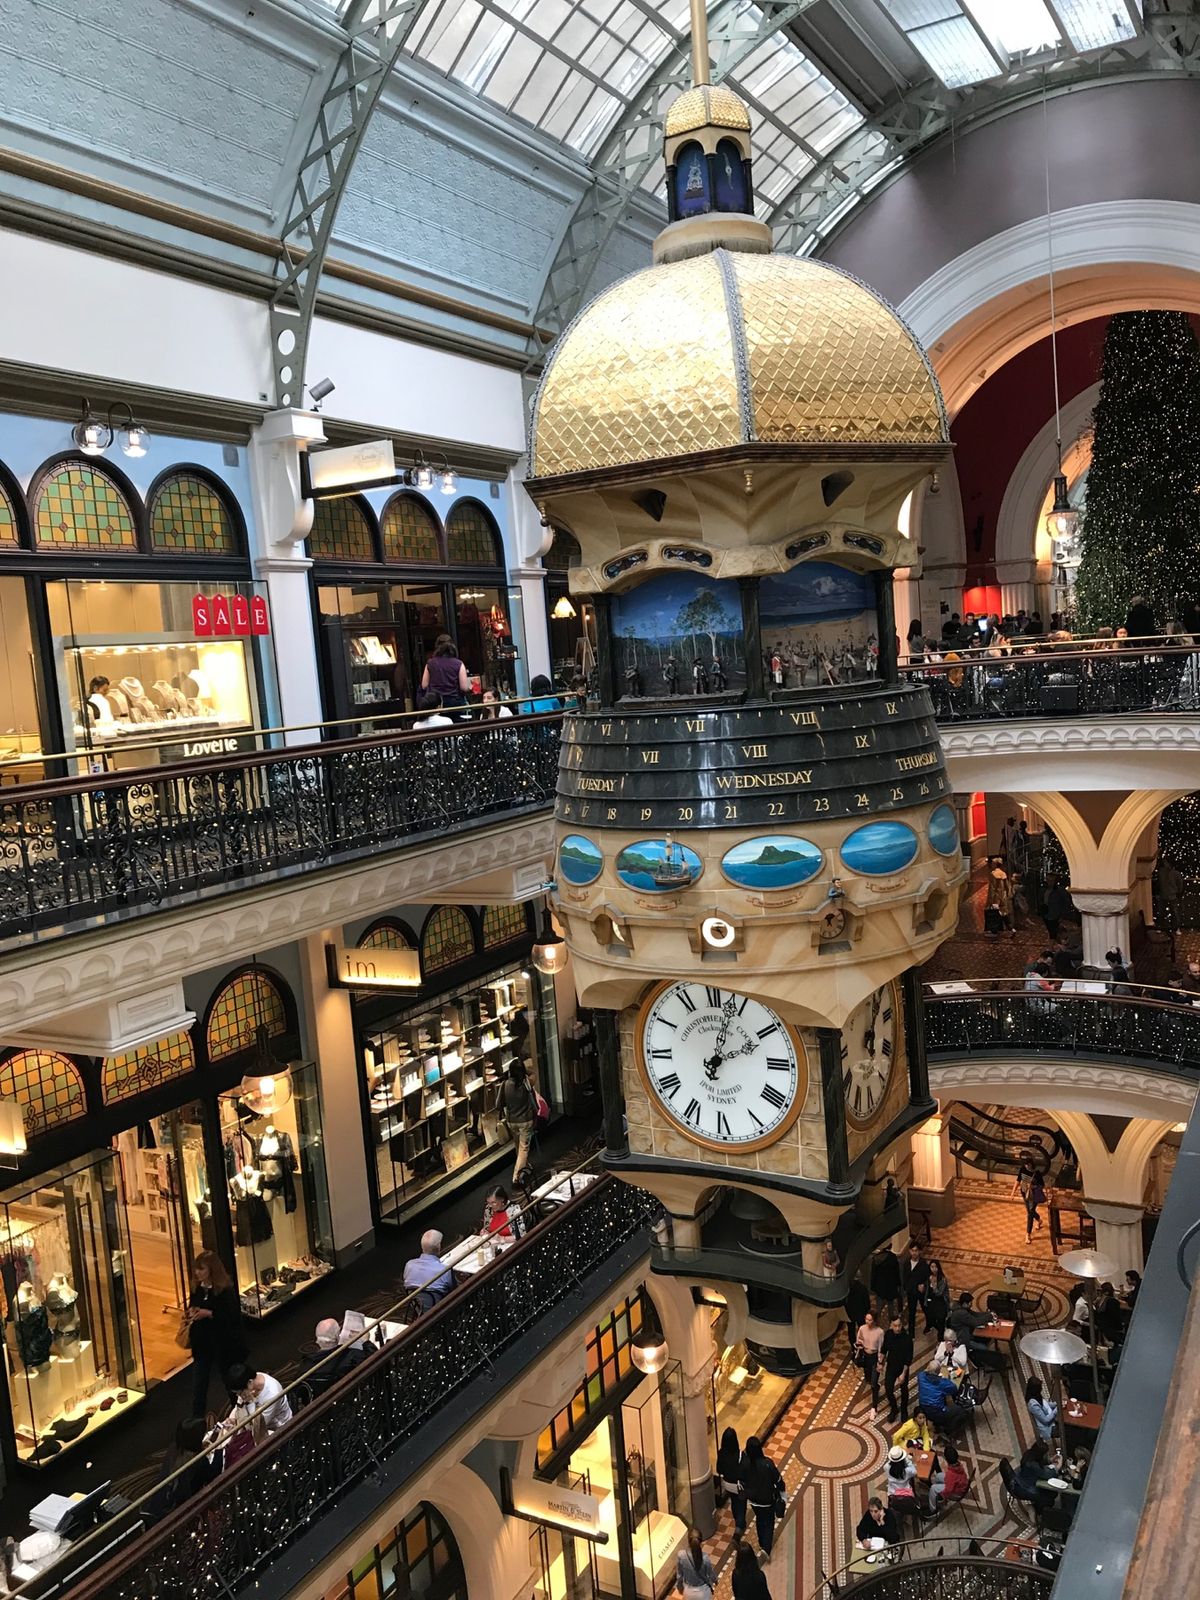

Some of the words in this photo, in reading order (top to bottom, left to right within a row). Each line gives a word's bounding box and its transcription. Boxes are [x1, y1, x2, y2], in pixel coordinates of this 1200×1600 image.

[197, 608, 265, 626] SALE
[601, 724, 612, 736] VI
[685, 720, 705, 733] VII
[790, 711, 816, 726] VIII
[885, 702, 899, 715] IX
[641, 751, 659, 764] VII
[742, 744, 768, 758] VIII
[854, 734, 871, 749] IX
[577, 777, 617, 792] TUESDAY
[716, 769, 813, 789] WEDNESDAY
[895, 751, 938, 771] THURSDAY
[606, 807, 617, 821] 18
[640, 808, 652, 821] 19
[678, 807, 693, 821] 20
[724, 805, 738, 819] 21
[767, 802, 785, 816] 22
[813, 797, 830, 812] 23
[854, 793, 870, 807] 24
[889, 786, 904, 801] 25
[917, 782, 930, 796] 26
[346, 955, 377, 978] im
[707, 1094, 738, 1105] SYDNEY
